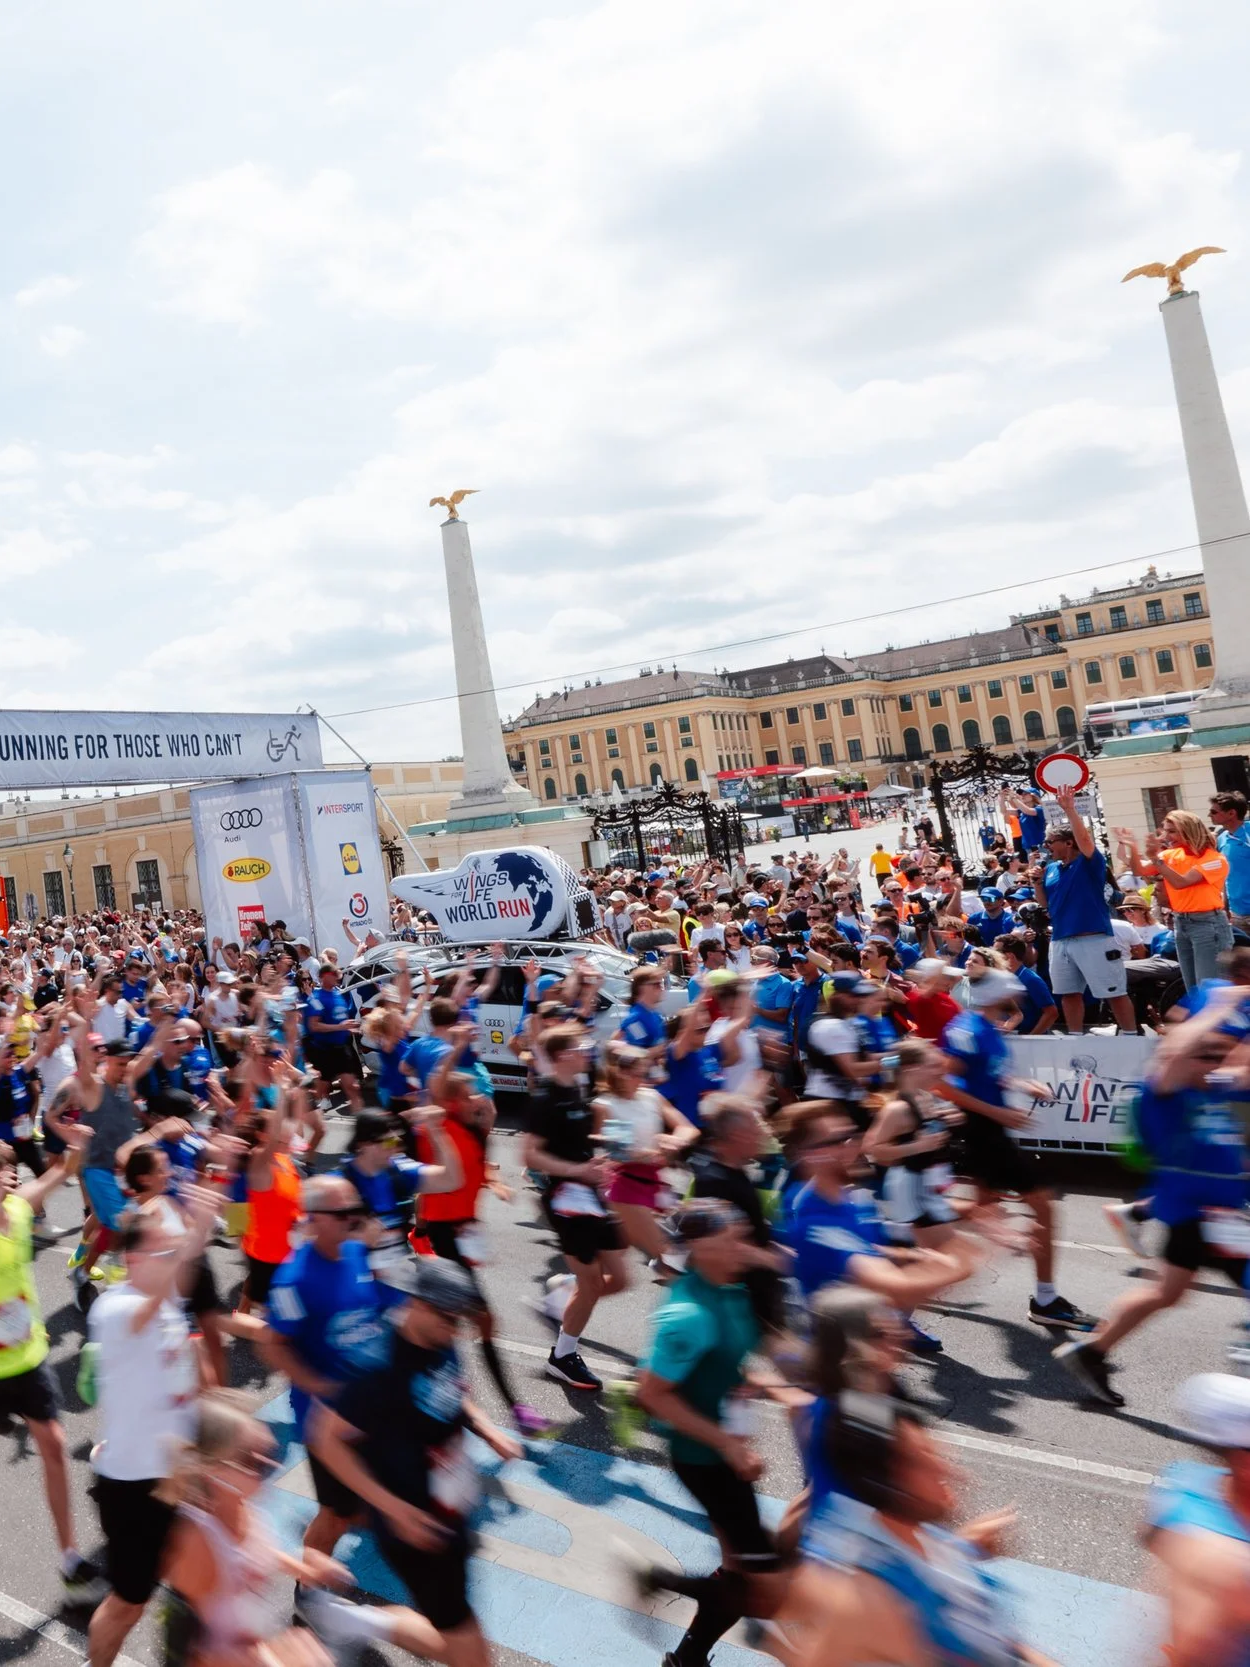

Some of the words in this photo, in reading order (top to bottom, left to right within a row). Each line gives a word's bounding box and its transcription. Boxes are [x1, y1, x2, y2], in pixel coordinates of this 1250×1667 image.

[74, 734, 110, 760] FOR
[113, 733, 163, 758] THOSE
[166, 733, 201, 757] WHO
[204, 733, 242, 756] CAN'T
[324, 803, 364, 815] INTERSPORT
[224, 835, 242, 843] Audi
[234, 863, 266, 877] RAUCH
[238, 909, 264, 920] Kronen
